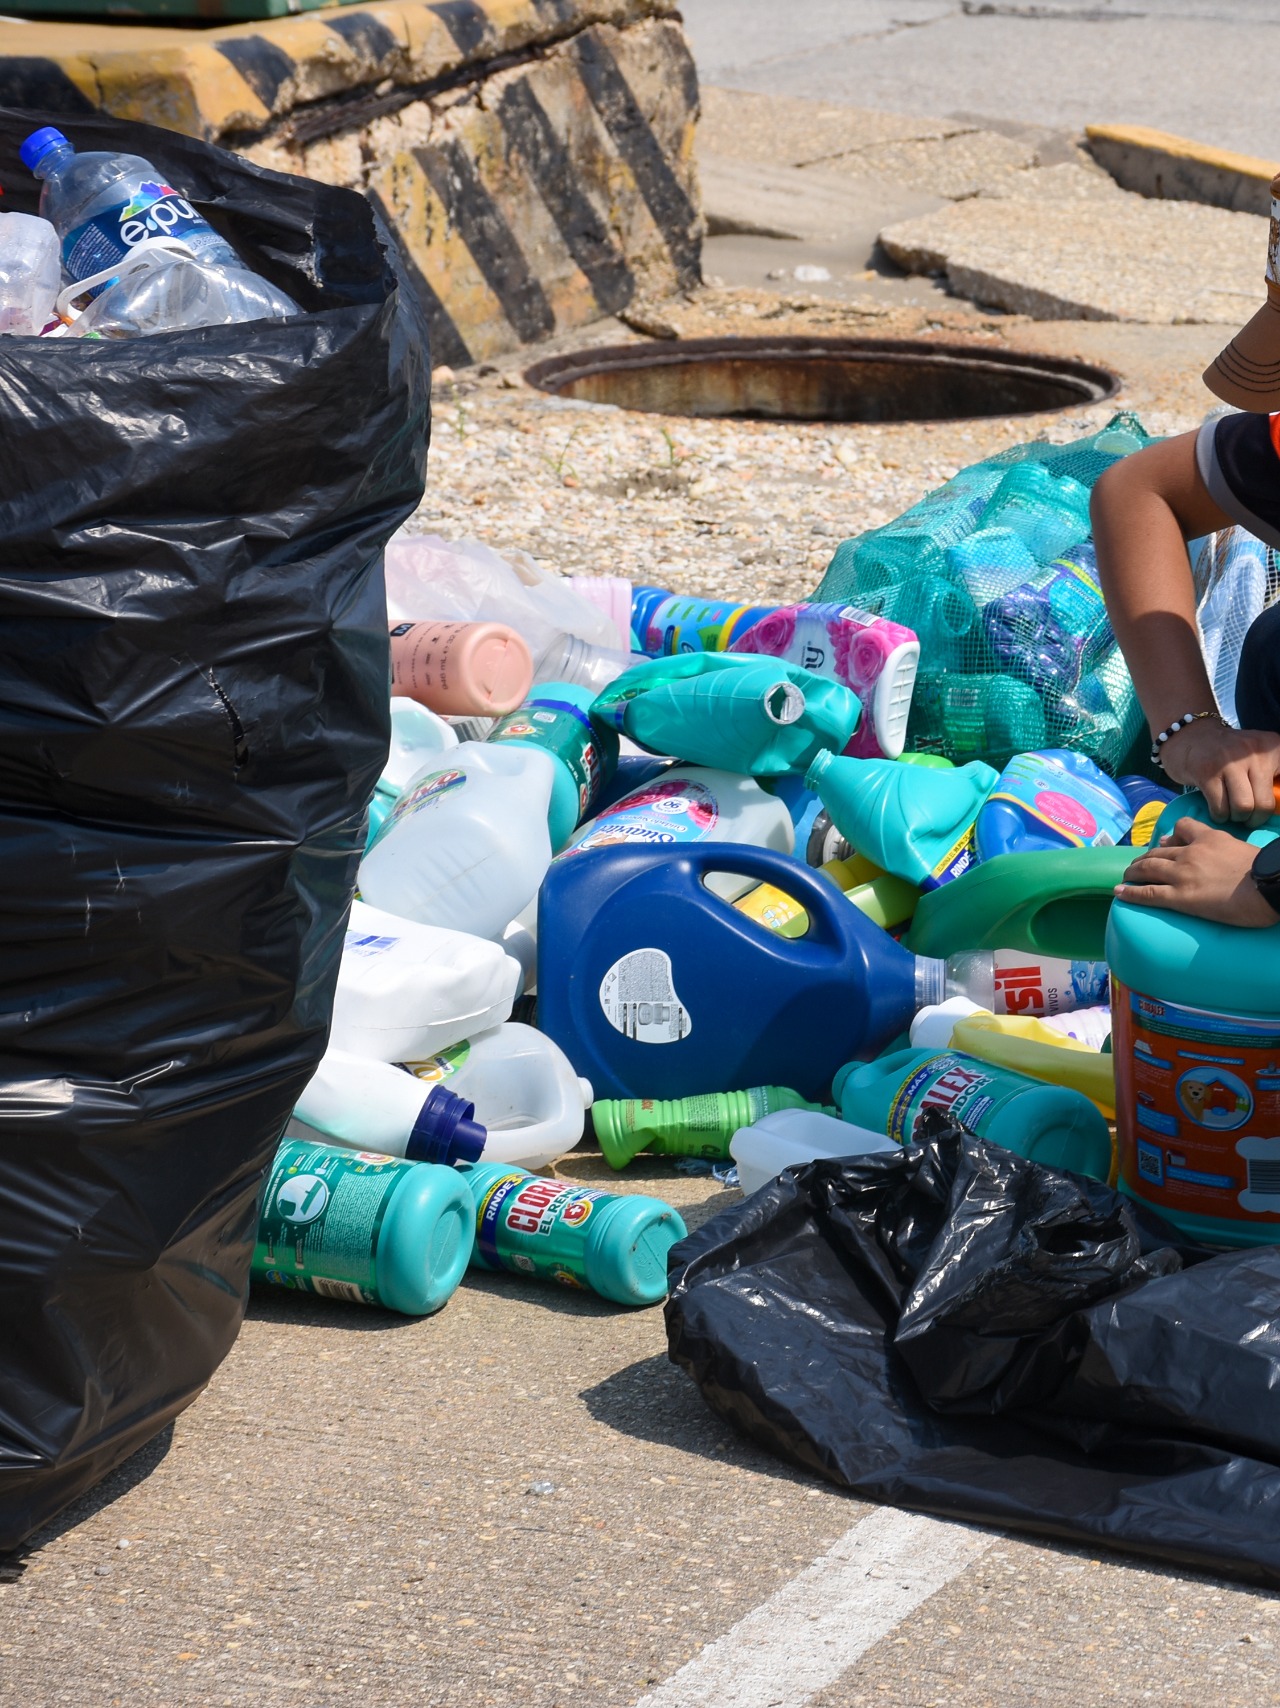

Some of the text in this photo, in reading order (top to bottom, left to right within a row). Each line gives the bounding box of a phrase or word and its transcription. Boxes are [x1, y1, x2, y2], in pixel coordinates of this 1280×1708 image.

[950, 851, 973, 878] RINDE
[1048, 988, 1058, 1012] VIVOS
[907, 1071, 929, 1096] MÁS
[486, 1181, 514, 1220] RINDE
[539, 1216, 554, 1234] EL
